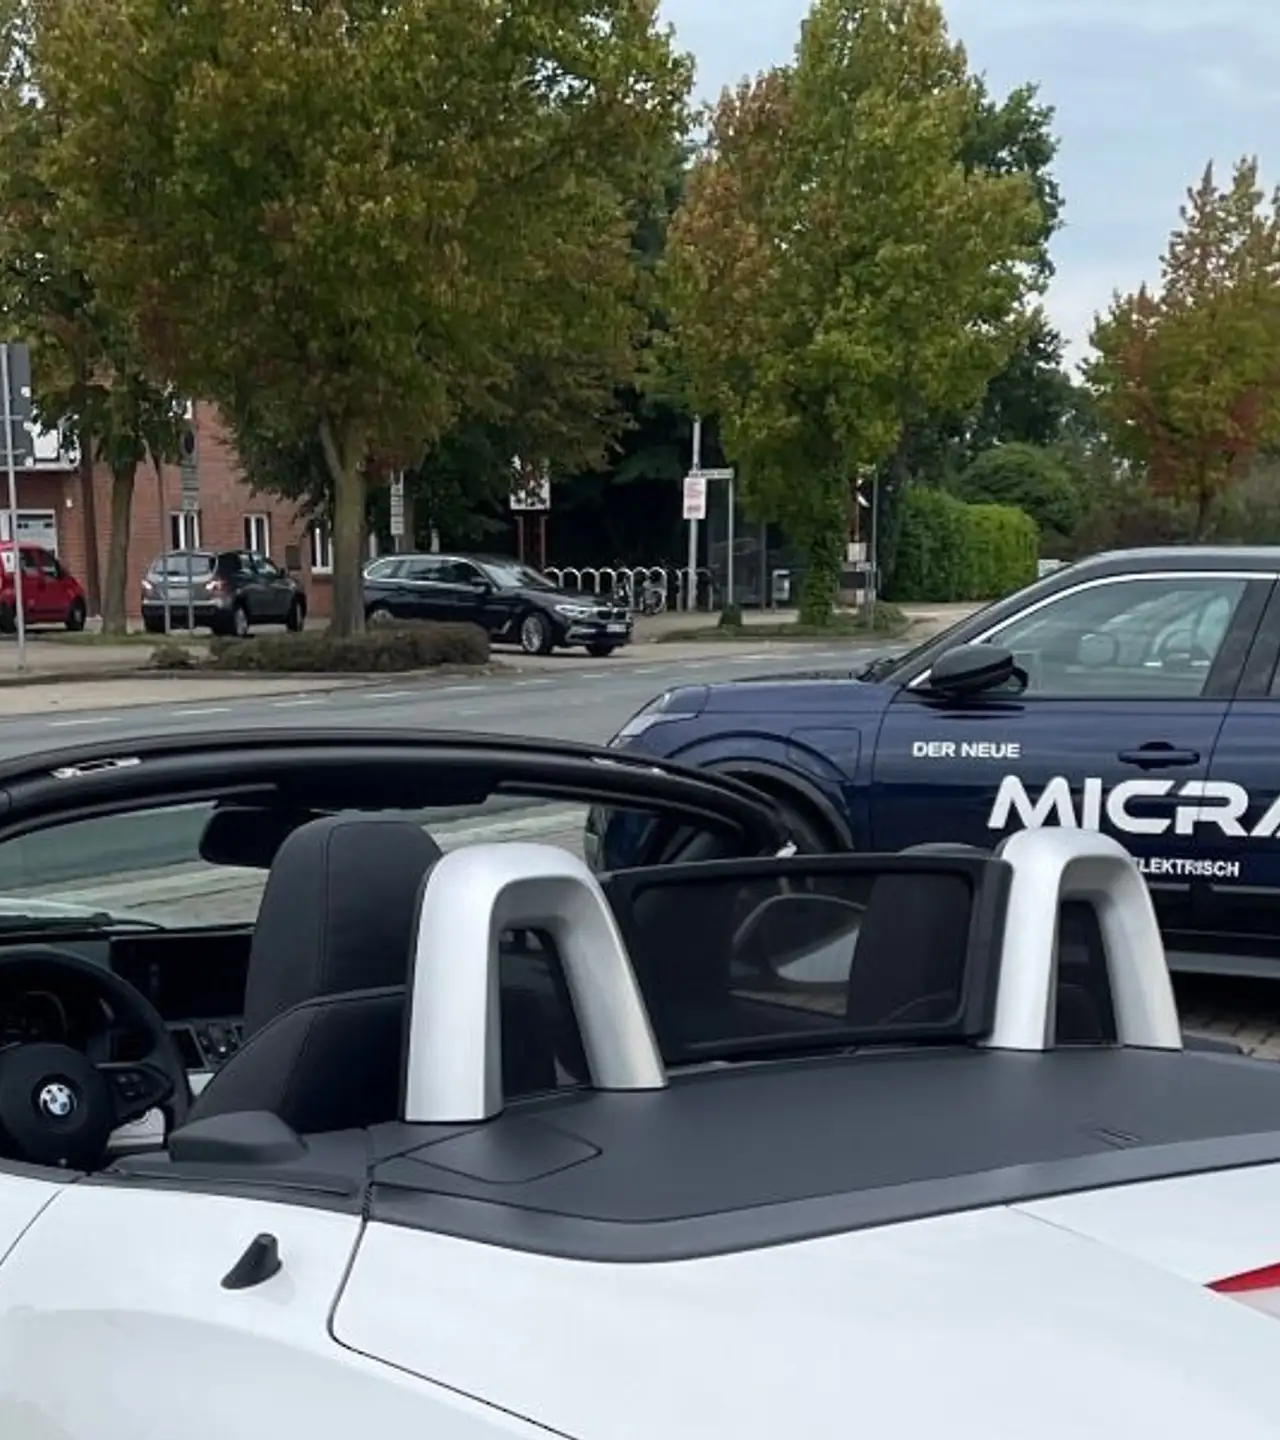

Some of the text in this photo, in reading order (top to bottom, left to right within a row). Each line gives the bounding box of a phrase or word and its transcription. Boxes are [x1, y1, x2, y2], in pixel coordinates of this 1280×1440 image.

[912, 741, 1021, 759] DER NEUE
[1131, 856, 1240, 878] LEKTRISCH
